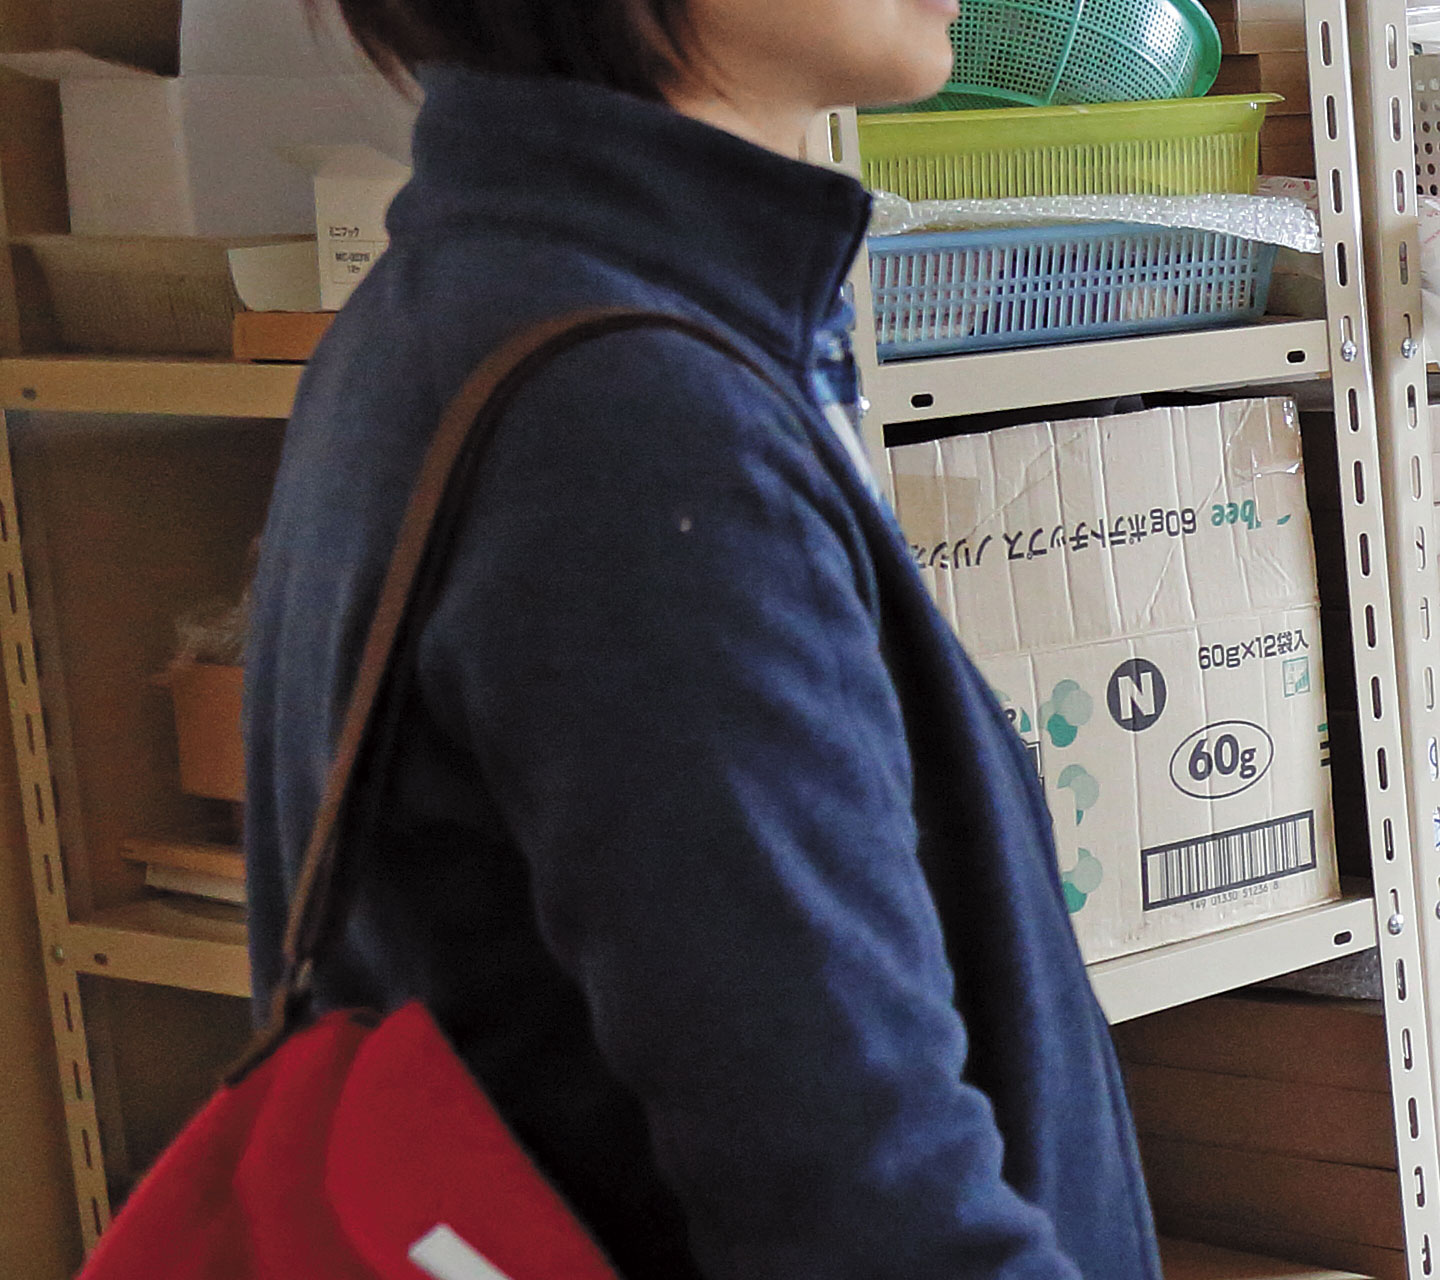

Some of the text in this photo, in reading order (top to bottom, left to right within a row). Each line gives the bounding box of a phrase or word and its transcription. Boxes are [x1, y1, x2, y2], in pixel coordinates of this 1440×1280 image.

[1117, 671, 1156, 721] N
[1188, 734, 1257, 781] 60g
[1190, 880, 1279, 911] 149 01330 51236 8
